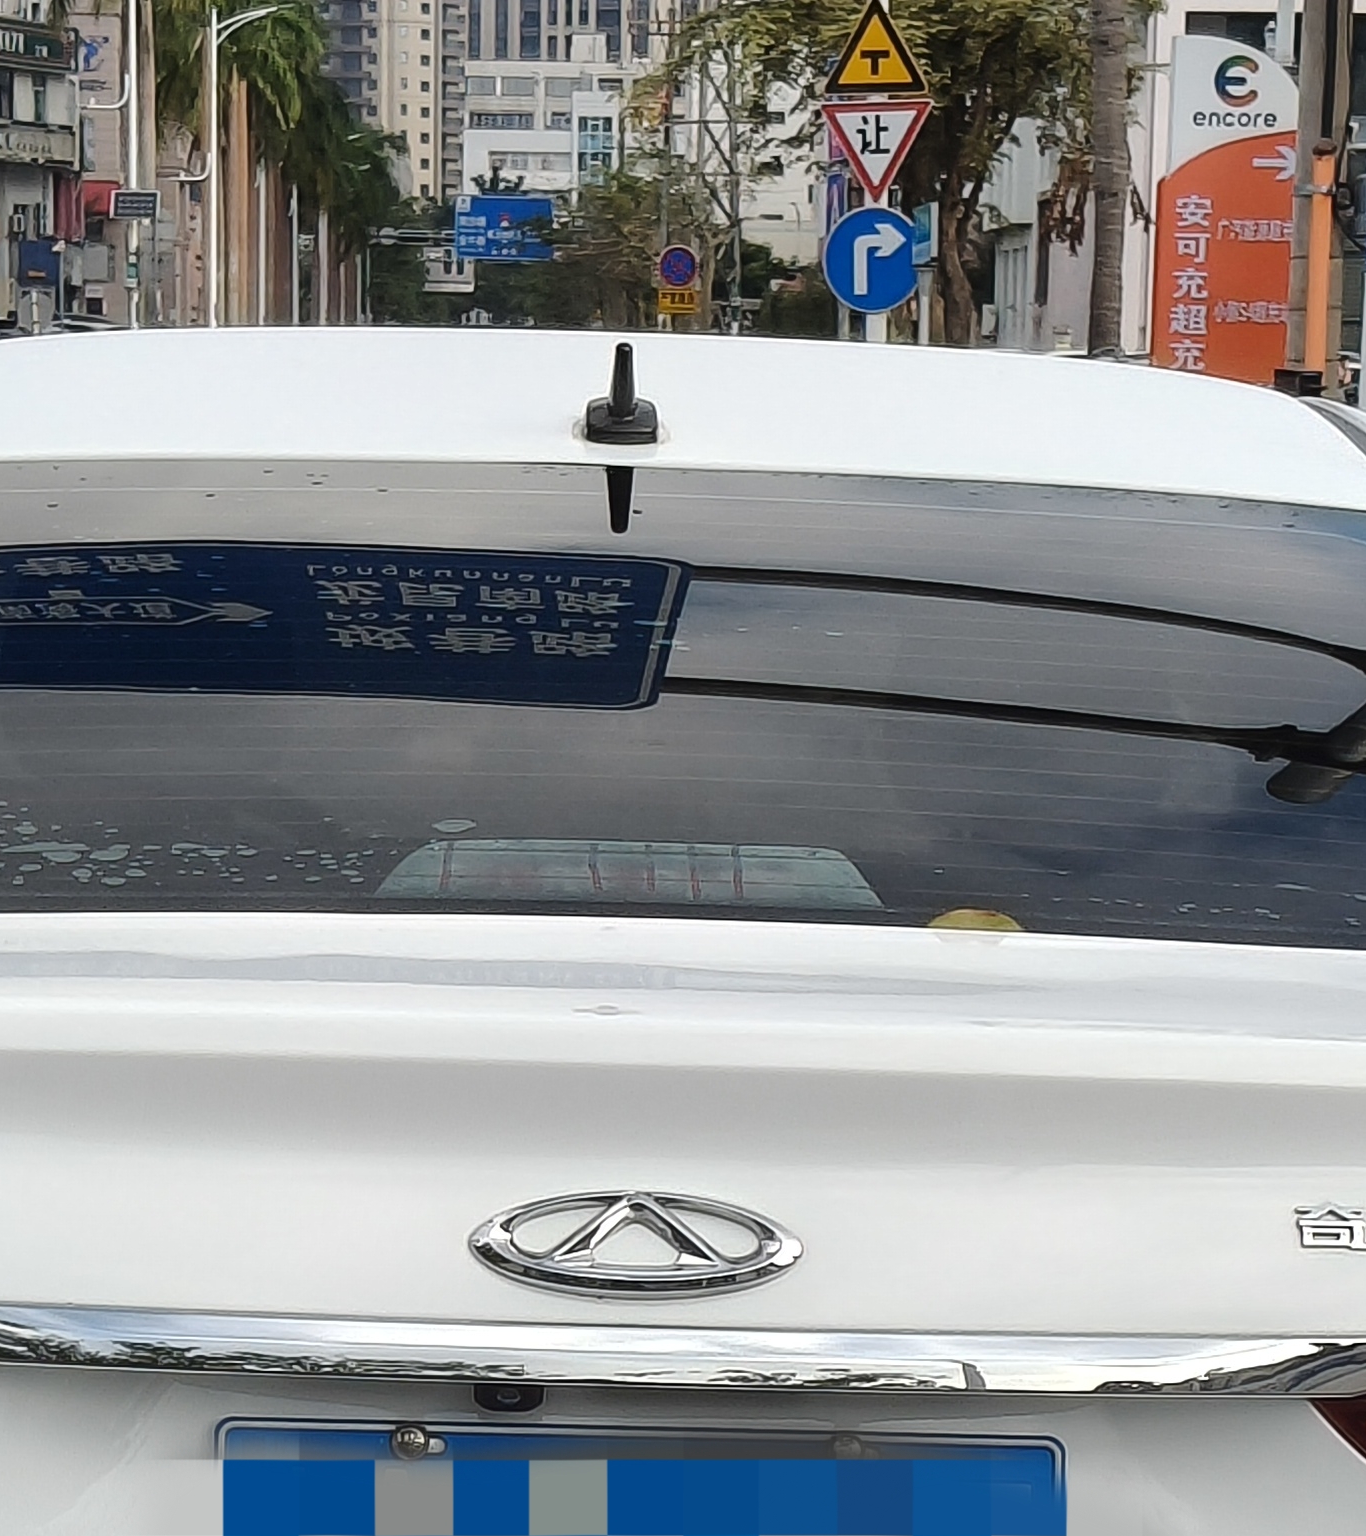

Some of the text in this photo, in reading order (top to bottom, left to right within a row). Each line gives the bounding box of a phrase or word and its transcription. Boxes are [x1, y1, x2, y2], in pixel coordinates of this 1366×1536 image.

[856, 114, 890, 155] 让
[1193, 111, 1277, 127] encore
[1168, 194, 1213, 372] 安可充超充
